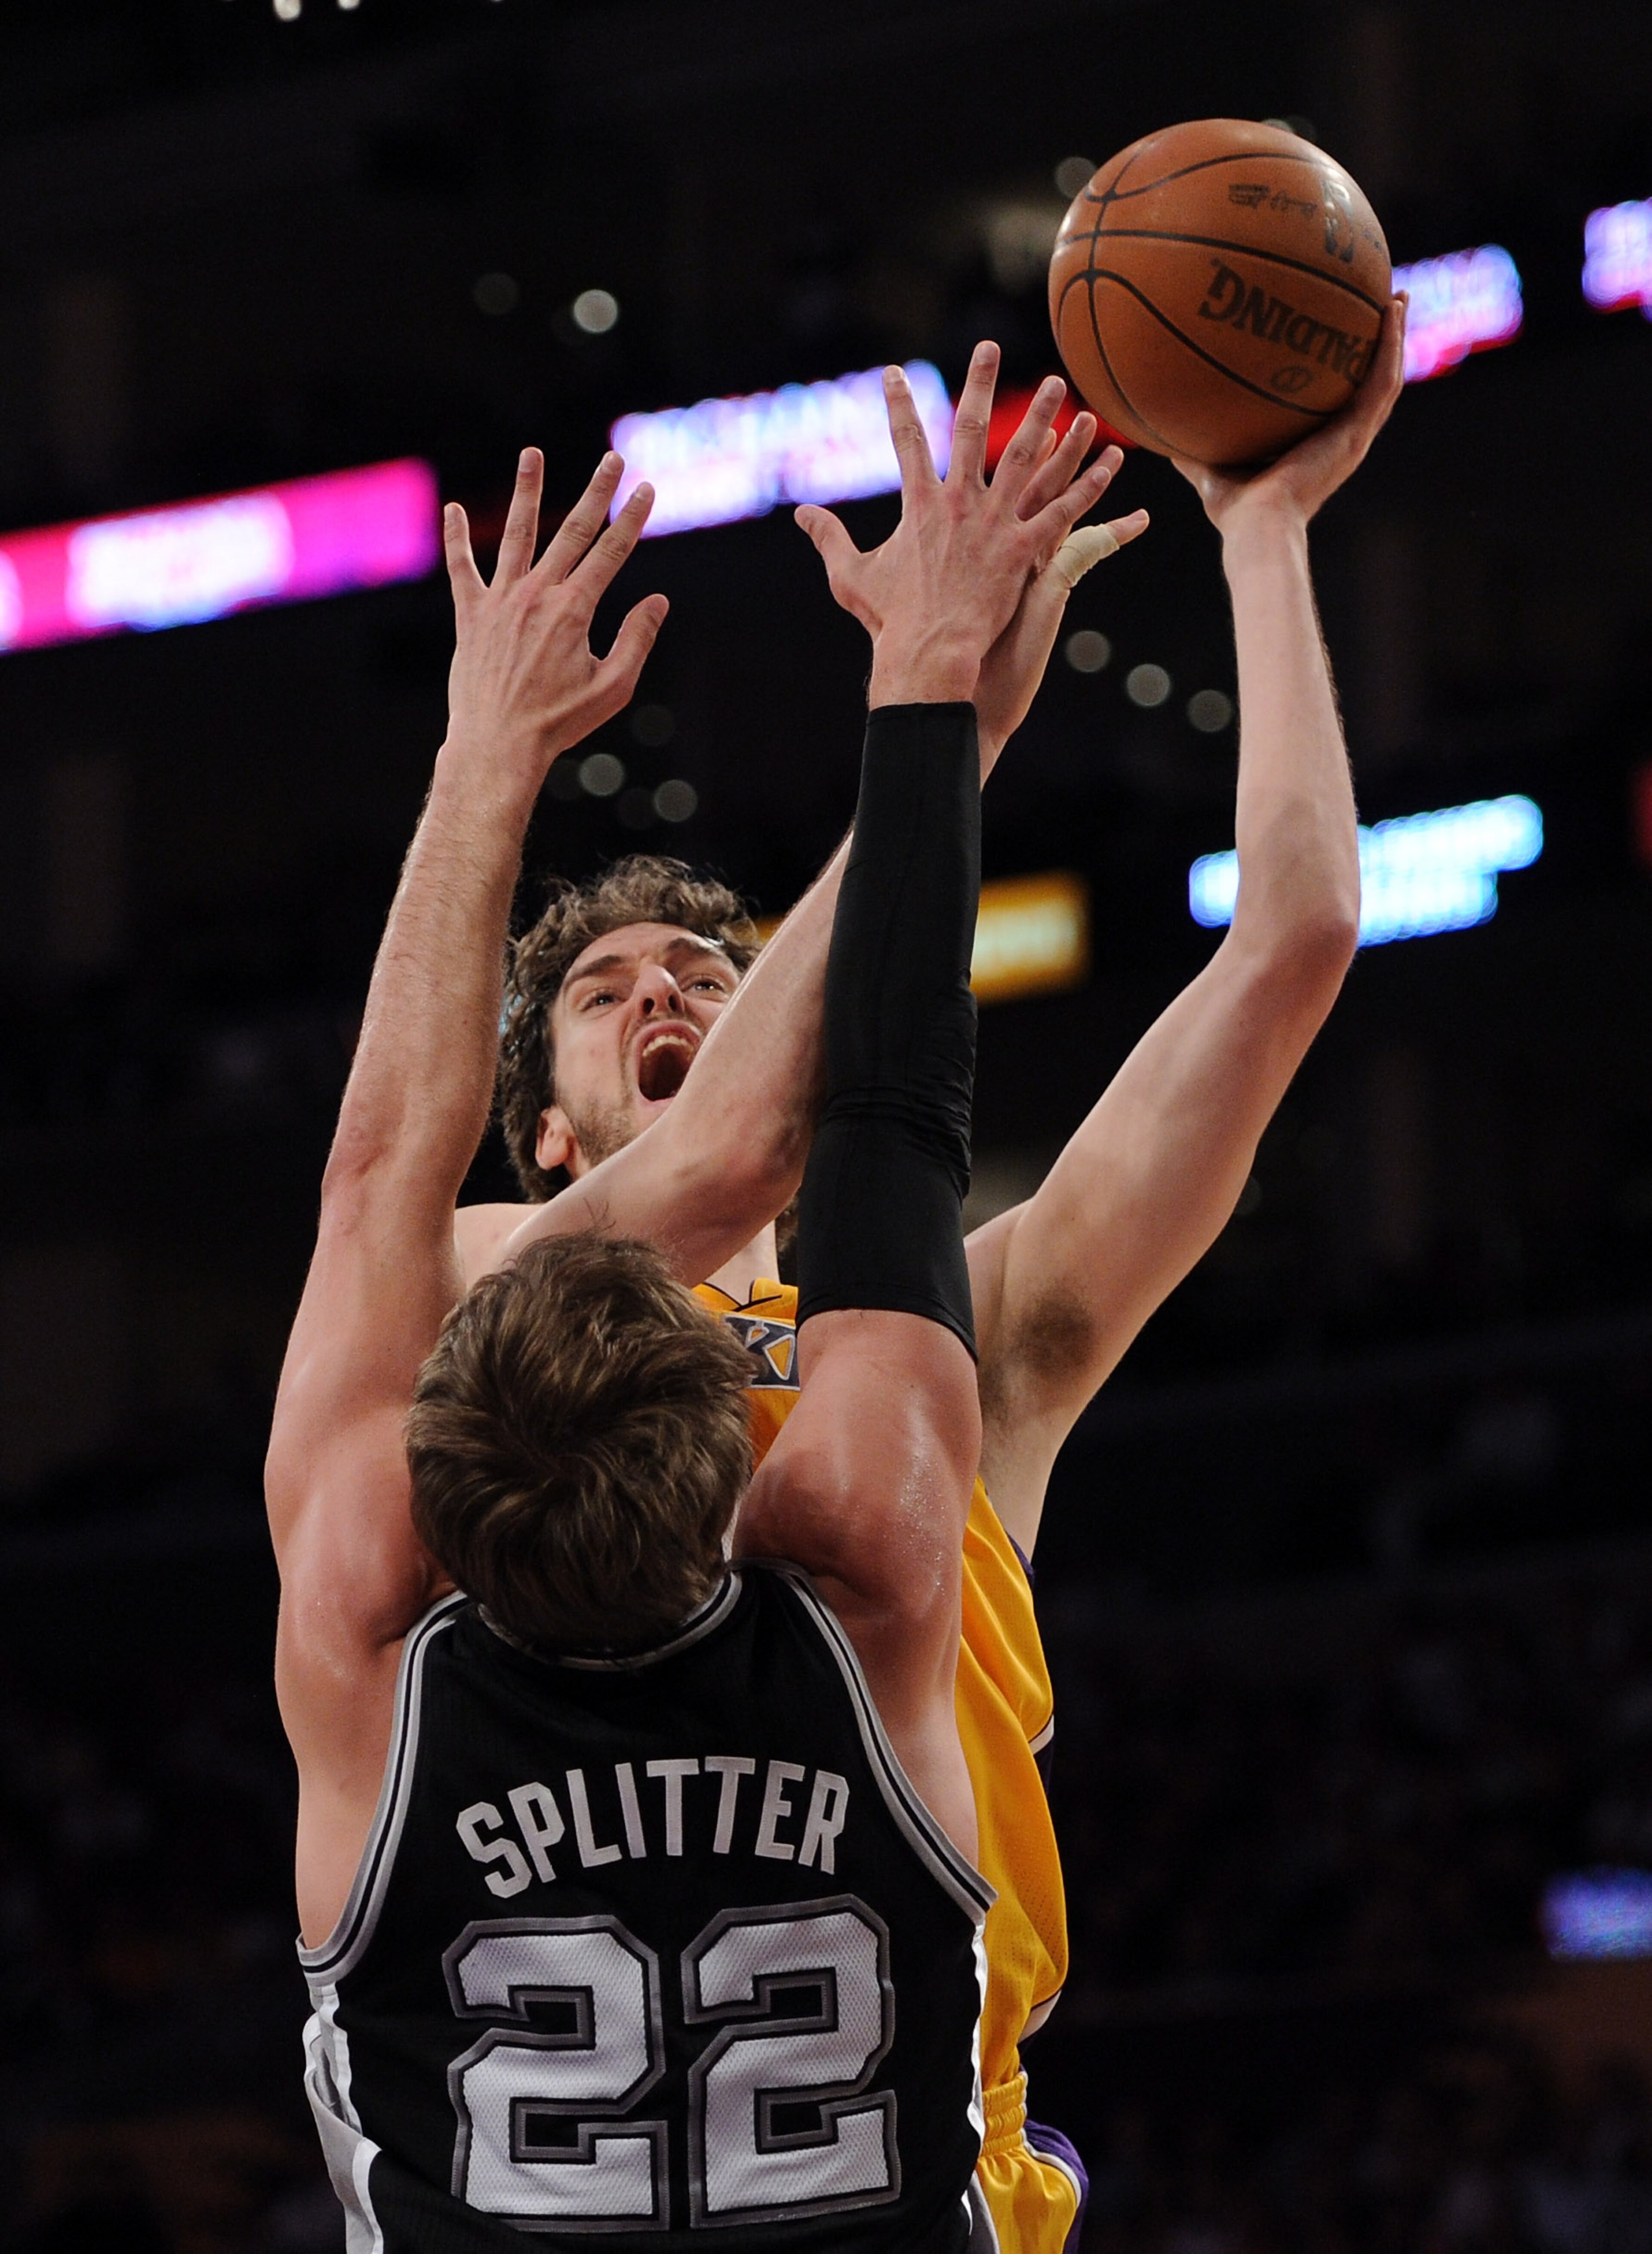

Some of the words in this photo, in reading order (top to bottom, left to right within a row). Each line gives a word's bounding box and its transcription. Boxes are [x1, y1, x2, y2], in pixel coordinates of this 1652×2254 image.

[1199, 263, 1378, 385] PALDING
[456, 1756, 849, 1898] SPLITTER
[442, 1894, 900, 2232] 22
